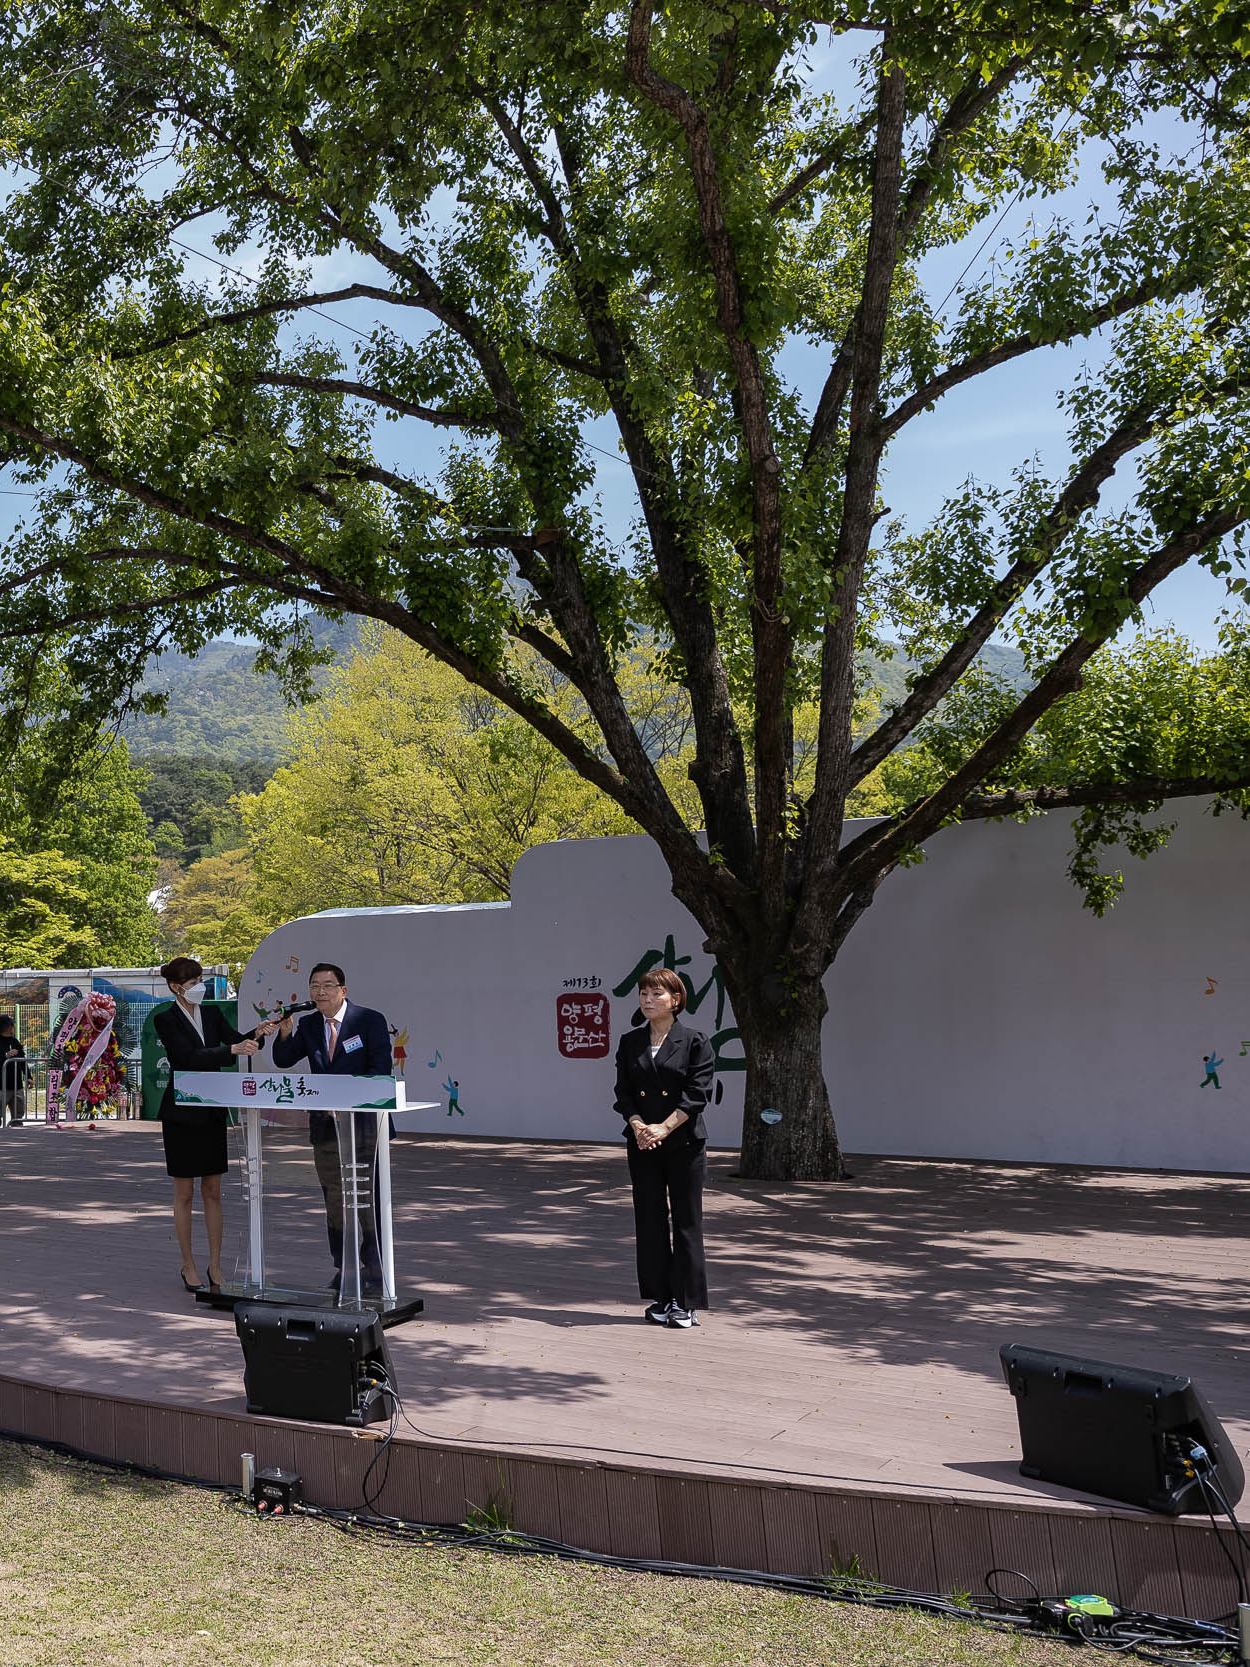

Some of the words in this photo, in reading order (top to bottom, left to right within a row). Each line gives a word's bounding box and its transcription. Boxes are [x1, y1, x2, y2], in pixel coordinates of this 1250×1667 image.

[562, 975, 602, 989] 제13회
[561, 1000, 603, 1024] 양평
[562, 1026, 607, 1052] 용문산
[259, 1076, 294, 1103] 산나물
[296, 1076, 319, 1097] 축제
